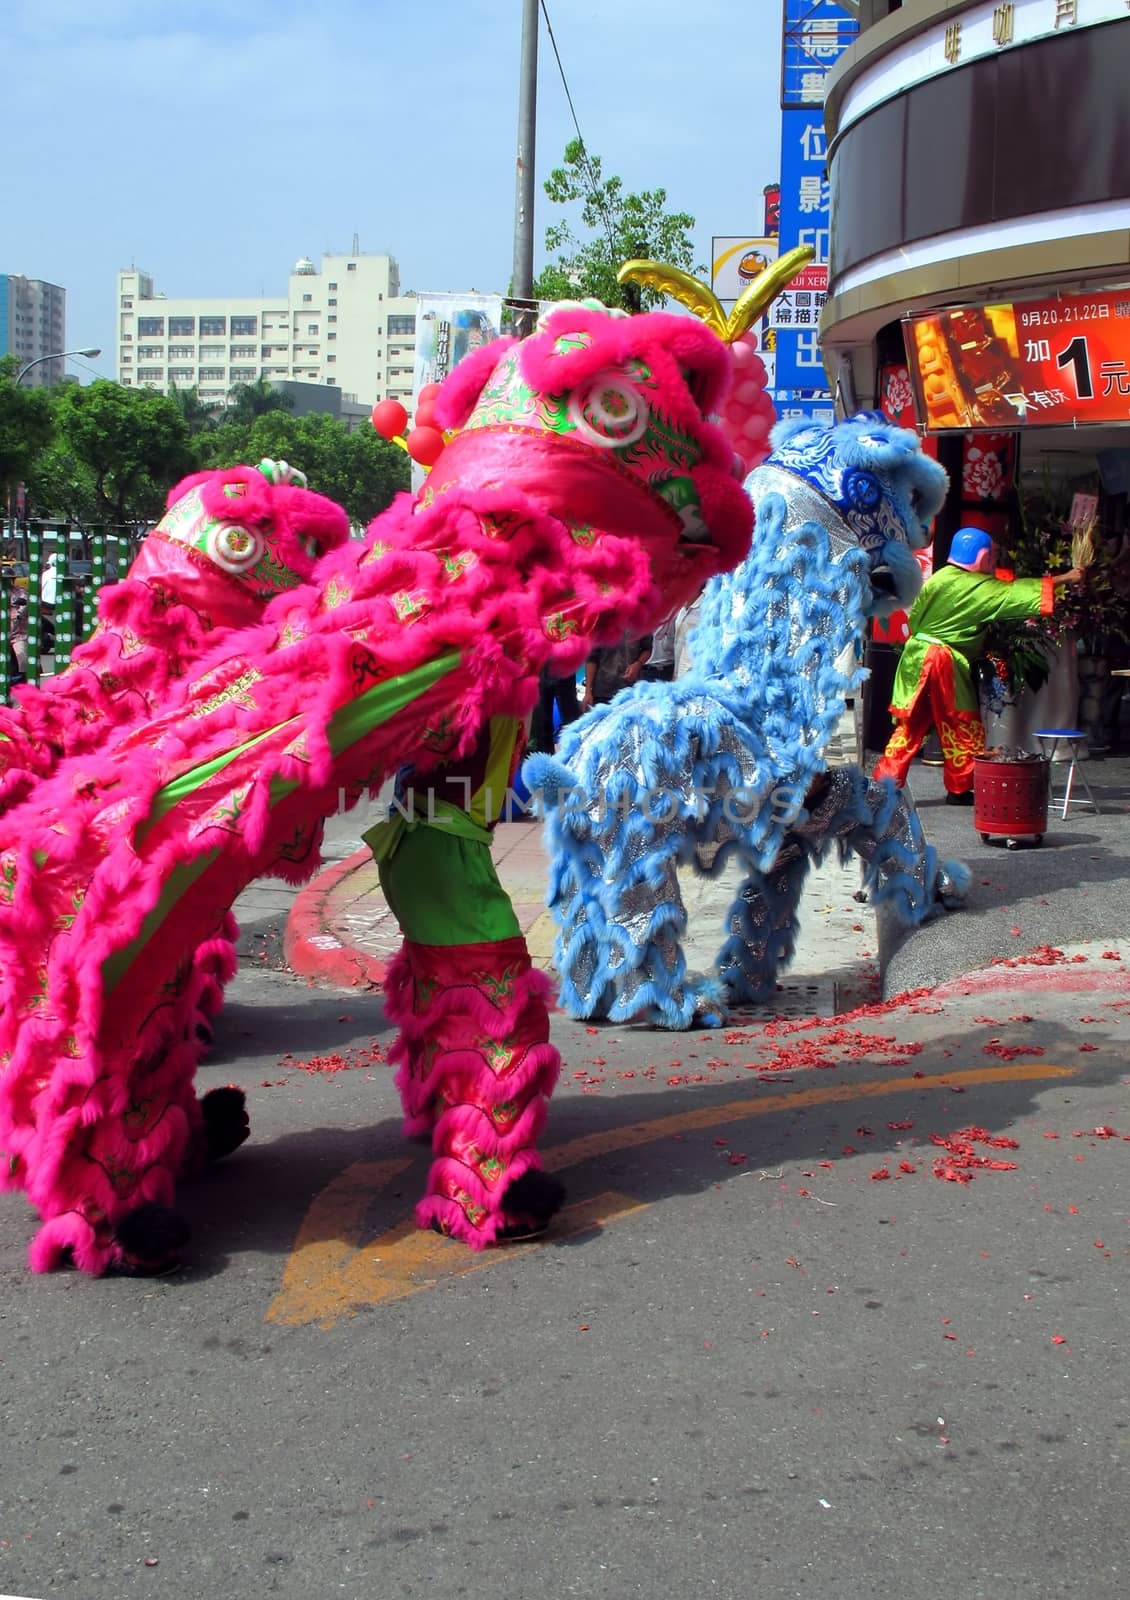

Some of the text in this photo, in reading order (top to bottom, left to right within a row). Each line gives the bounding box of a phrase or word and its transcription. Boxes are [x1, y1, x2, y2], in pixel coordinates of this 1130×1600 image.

[790, 277, 827, 286] UJI XER
[776, 308, 818, 323] 掃描
[1021, 303, 1110, 327] 9月20.21.22日
